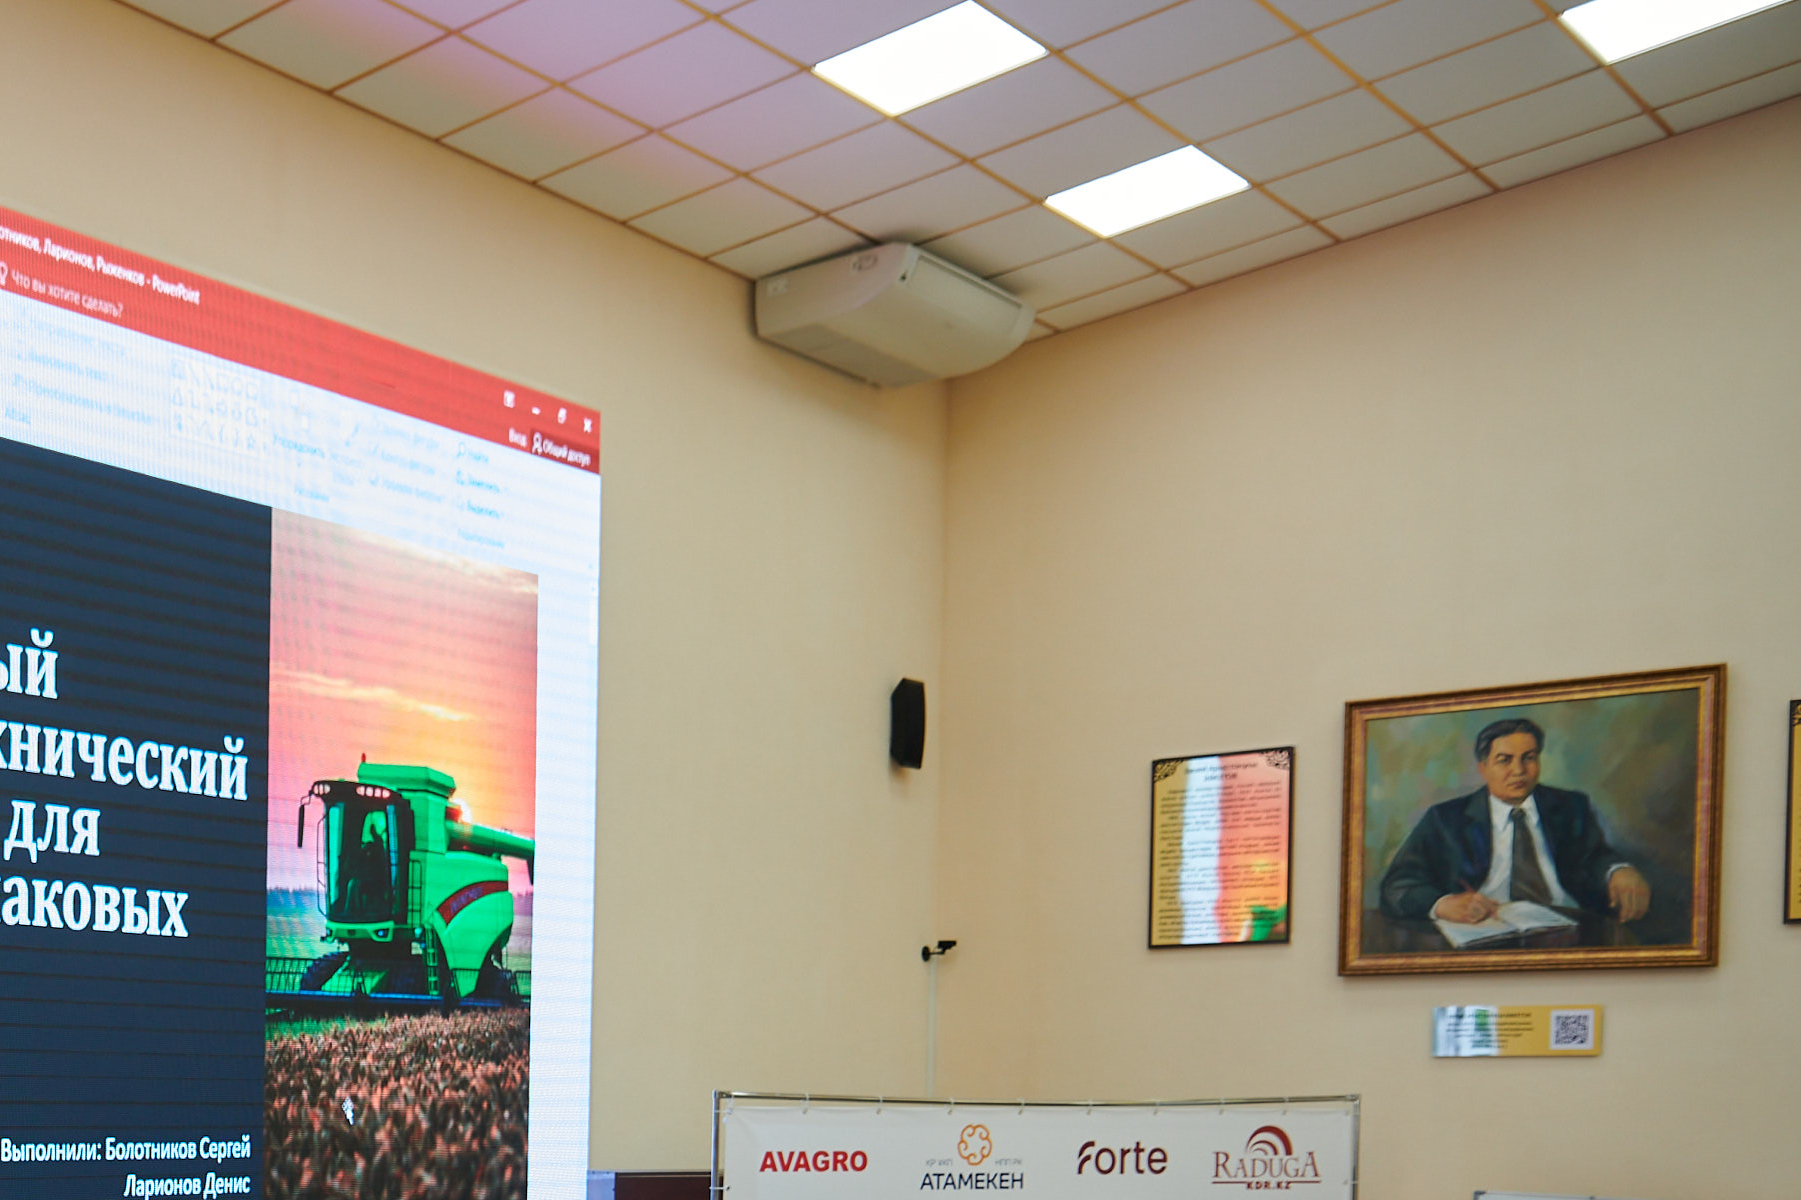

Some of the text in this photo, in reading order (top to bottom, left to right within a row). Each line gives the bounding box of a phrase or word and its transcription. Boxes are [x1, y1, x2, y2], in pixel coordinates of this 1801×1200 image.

[96, 255, 145, 287] Рыженков
[152, 274, 200, 305] PowerPoint
[3, 799, 101, 864] для
[0, 1134, 250, 1164] Выполнили: Болотников Сергей
[759, 1150, 868, 1172] AVAGRO
[1212, 1151, 1321, 1179] RADUGA
[203, 1172, 250, 1200] Денис
[1246, 1181, 1292, 1190] KDR.KZ
